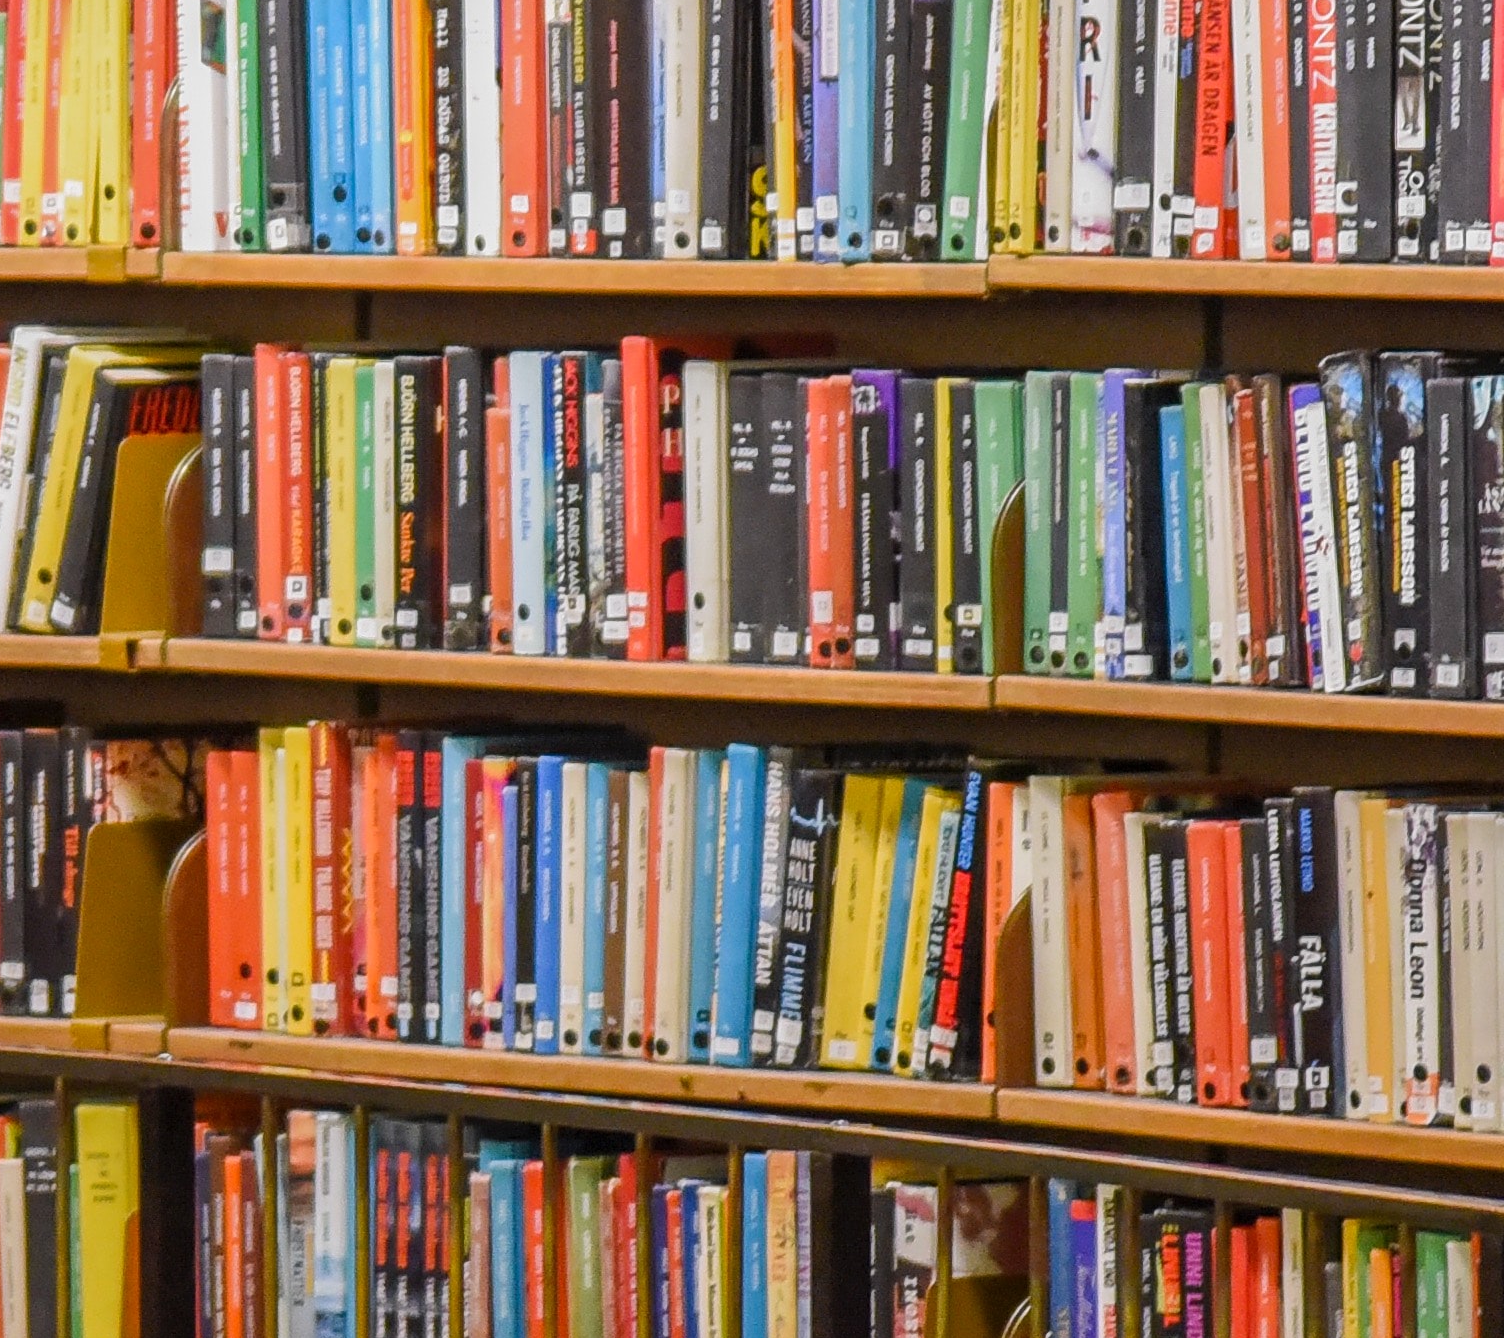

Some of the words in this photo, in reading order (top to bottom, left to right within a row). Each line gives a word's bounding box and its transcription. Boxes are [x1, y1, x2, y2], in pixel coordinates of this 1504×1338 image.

[573, 7, 585, 84] HANDBERG
[1204, 59, 1226, 82] ÄR
[573, 92, 586, 139] KLUBB
[1201, 87, 1222, 158] DRAGEN
[573, 142, 586, 186] IBSEN
[1313, 103, 1337, 214] KRITIKERN
[400, 374, 419, 424] BJÖRN
[290, 410, 303, 476] HELLBERG
[400, 426, 416, 504] HELLBERG
[563, 399, 579, 468] HIGGINS
[1343, 440, 1361, 496] STIEG
[1399, 445, 1416, 508] STIEG
[1346, 499, 1364, 596] LARSSON
[1399, 510, 1416, 605] LARSSON
[768, 760, 784, 816] HANS
[965, 771, 982, 810] EVAN
[957, 812, 975, 870] HUNTER
[1407, 857, 1428, 934] Donna
[779, 942, 807, 1019] FLIMME
[1298, 935, 1326, 1013] FÄLLA
[1408, 941, 1428, 999] Leon
[1185, 1231, 1204, 1287] UNNI
